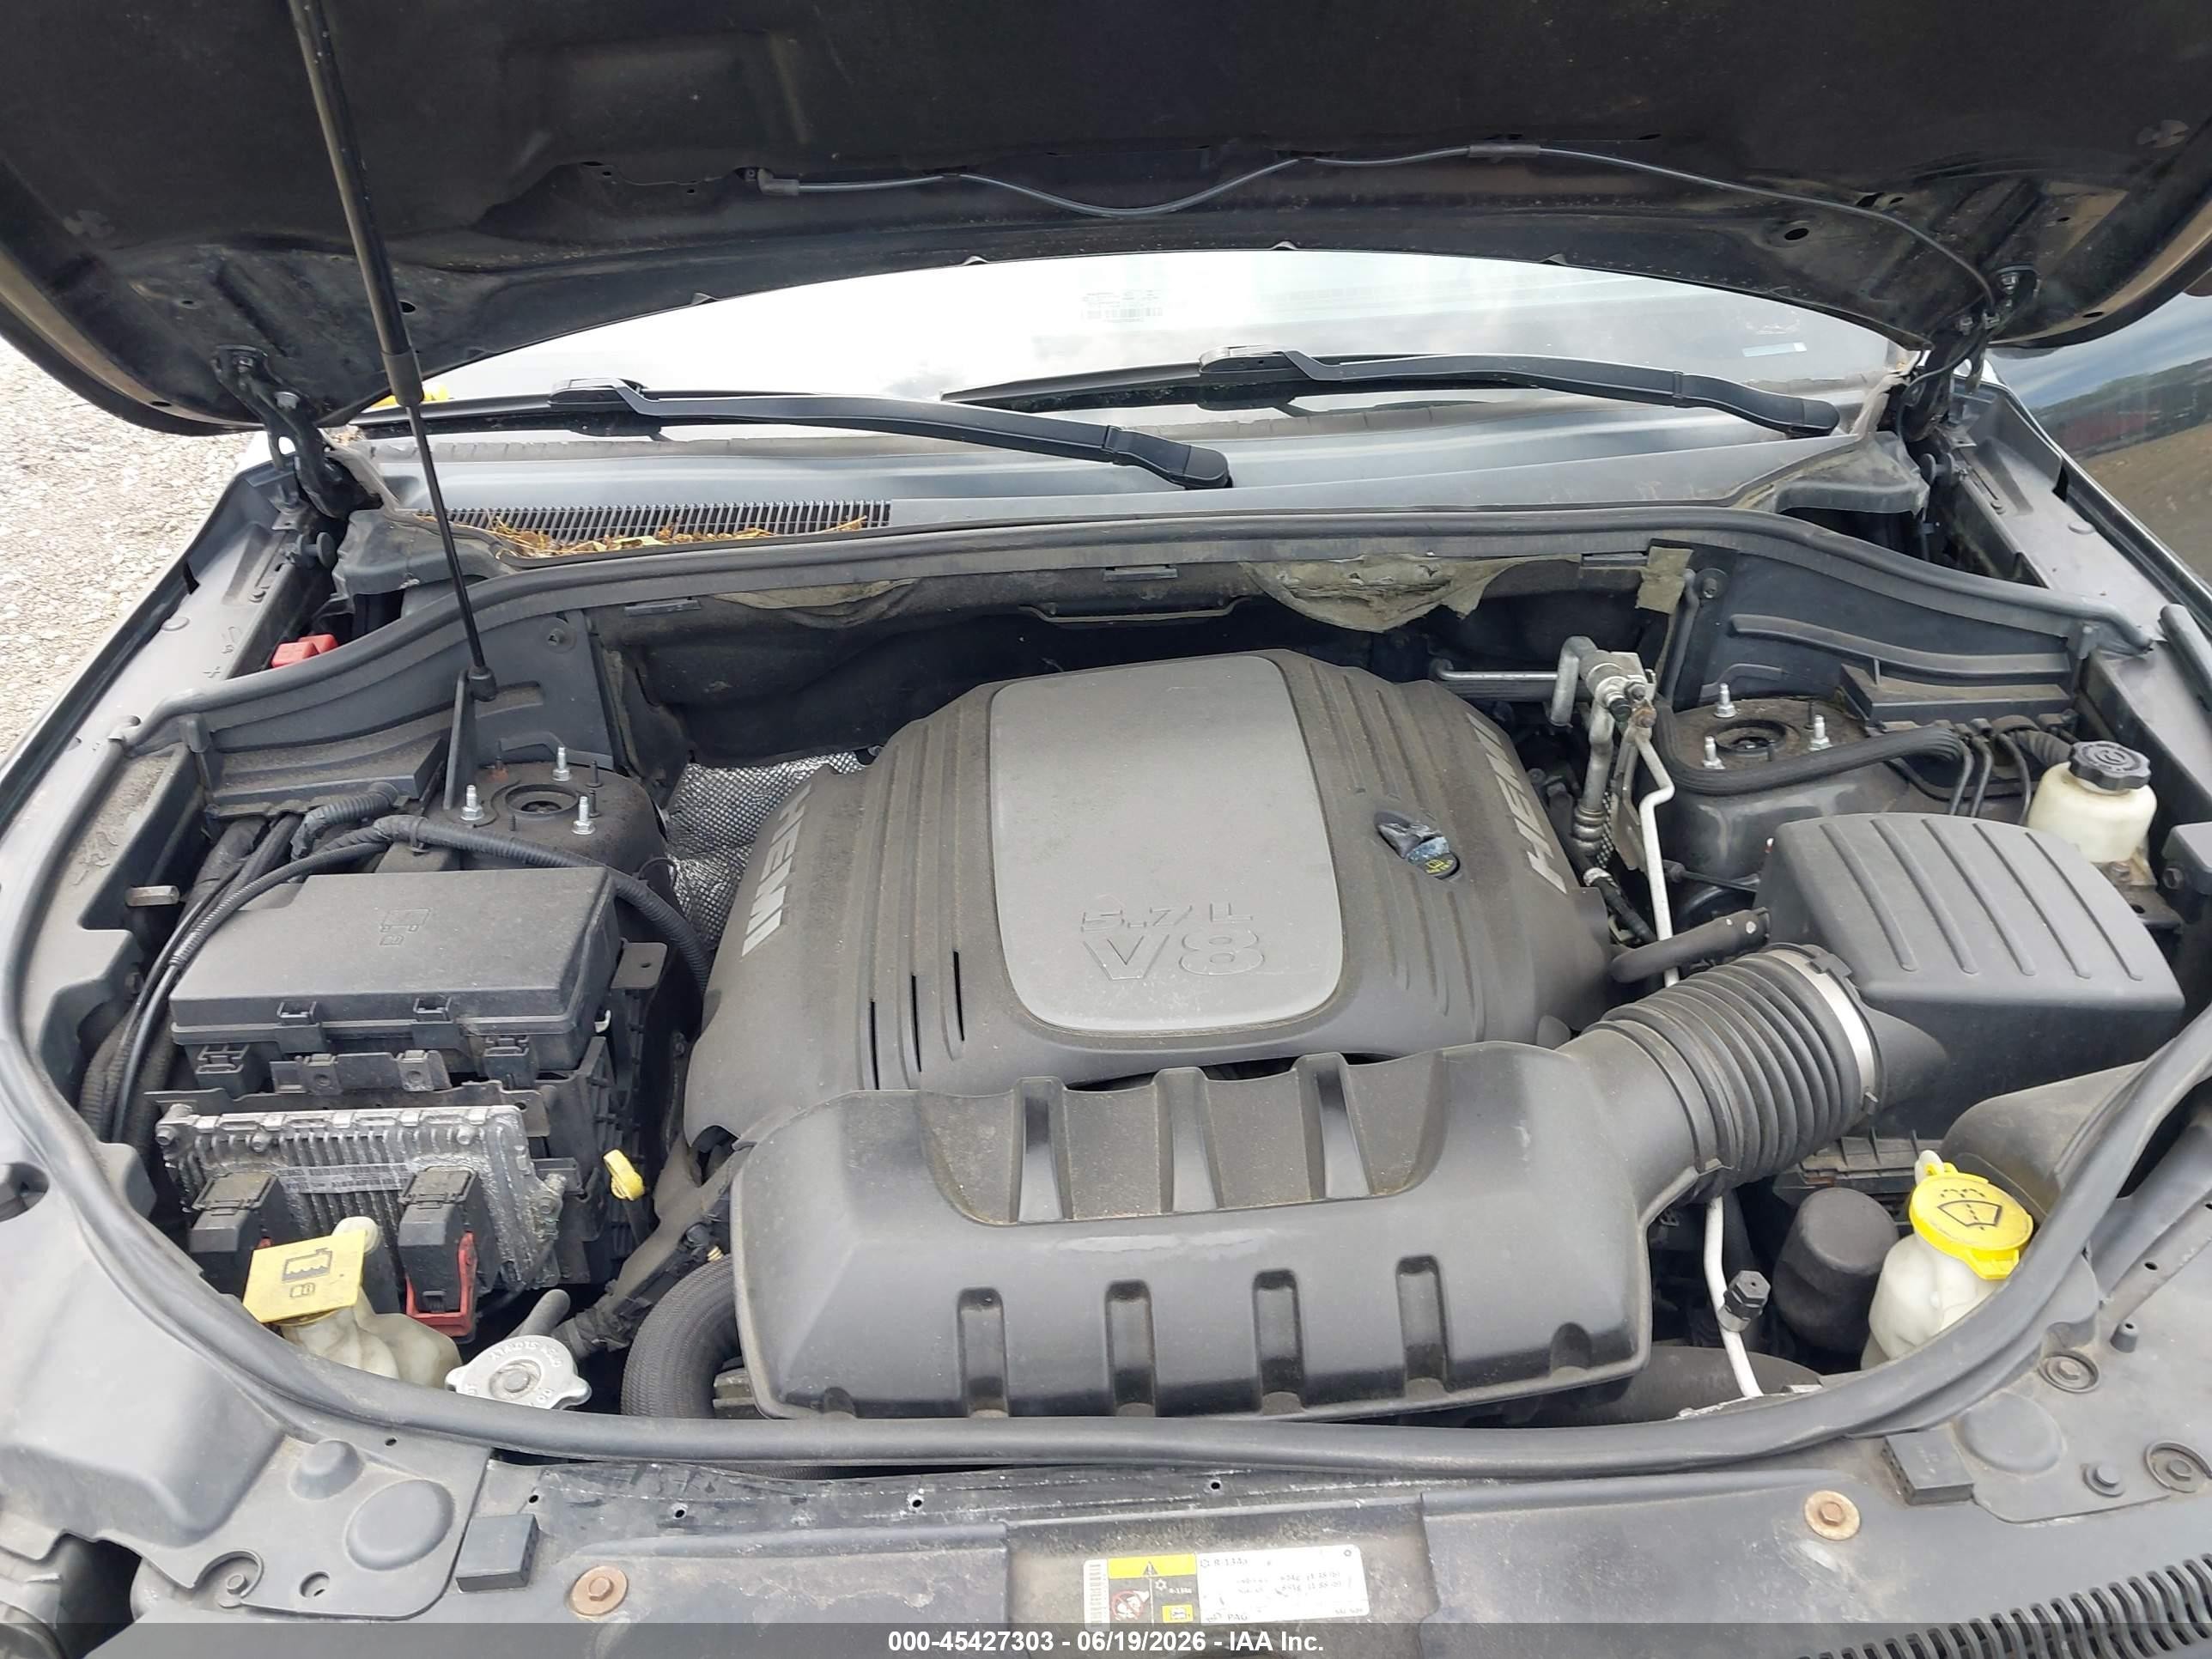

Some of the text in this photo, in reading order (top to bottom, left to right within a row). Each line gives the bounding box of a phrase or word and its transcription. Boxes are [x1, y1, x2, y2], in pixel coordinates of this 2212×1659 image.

[741, 783, 812, 958] HEMI
[1466, 712, 1567, 895] HEMI
[1082, 927, 1266, 981] V8
